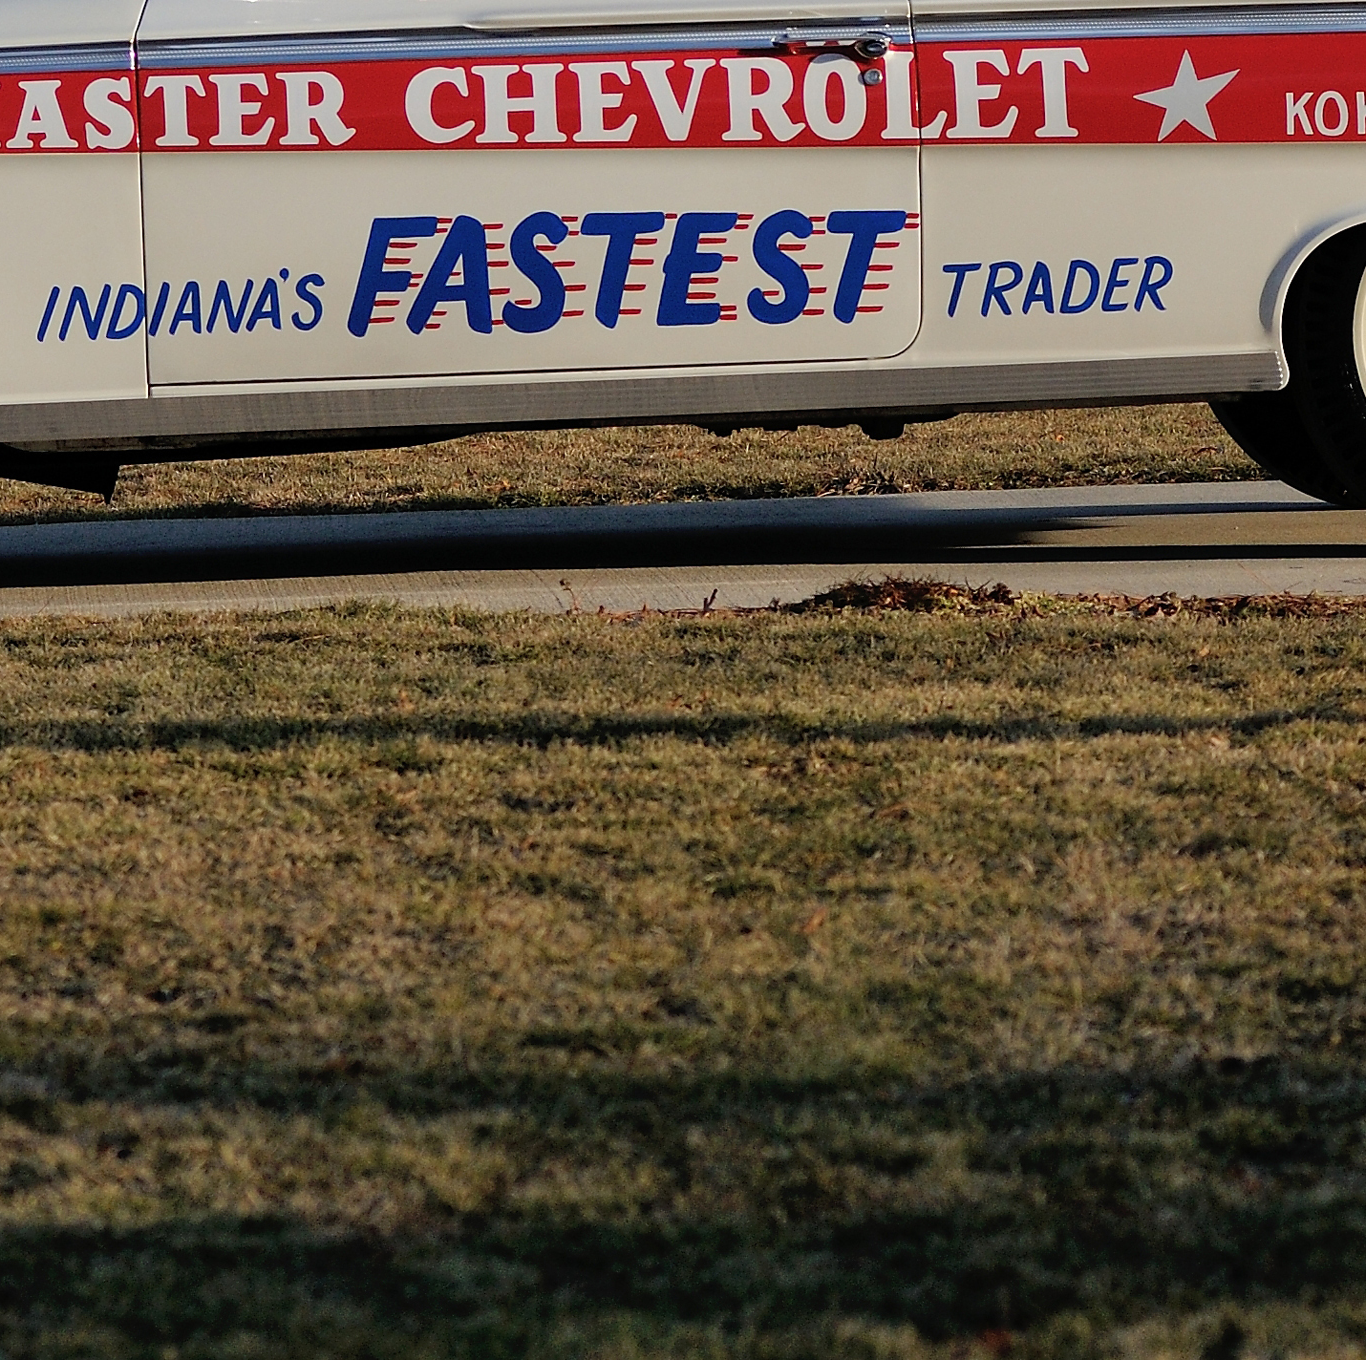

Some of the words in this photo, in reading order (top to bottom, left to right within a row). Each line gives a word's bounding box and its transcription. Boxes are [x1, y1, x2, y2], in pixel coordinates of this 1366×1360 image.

[404, 47, 1090, 144] CHEVROLET
[35, 263, 325, 342] INDIANA'S
[346, 209, 914, 338] FASTEST
[941, 254, 1174, 319] TRADER
